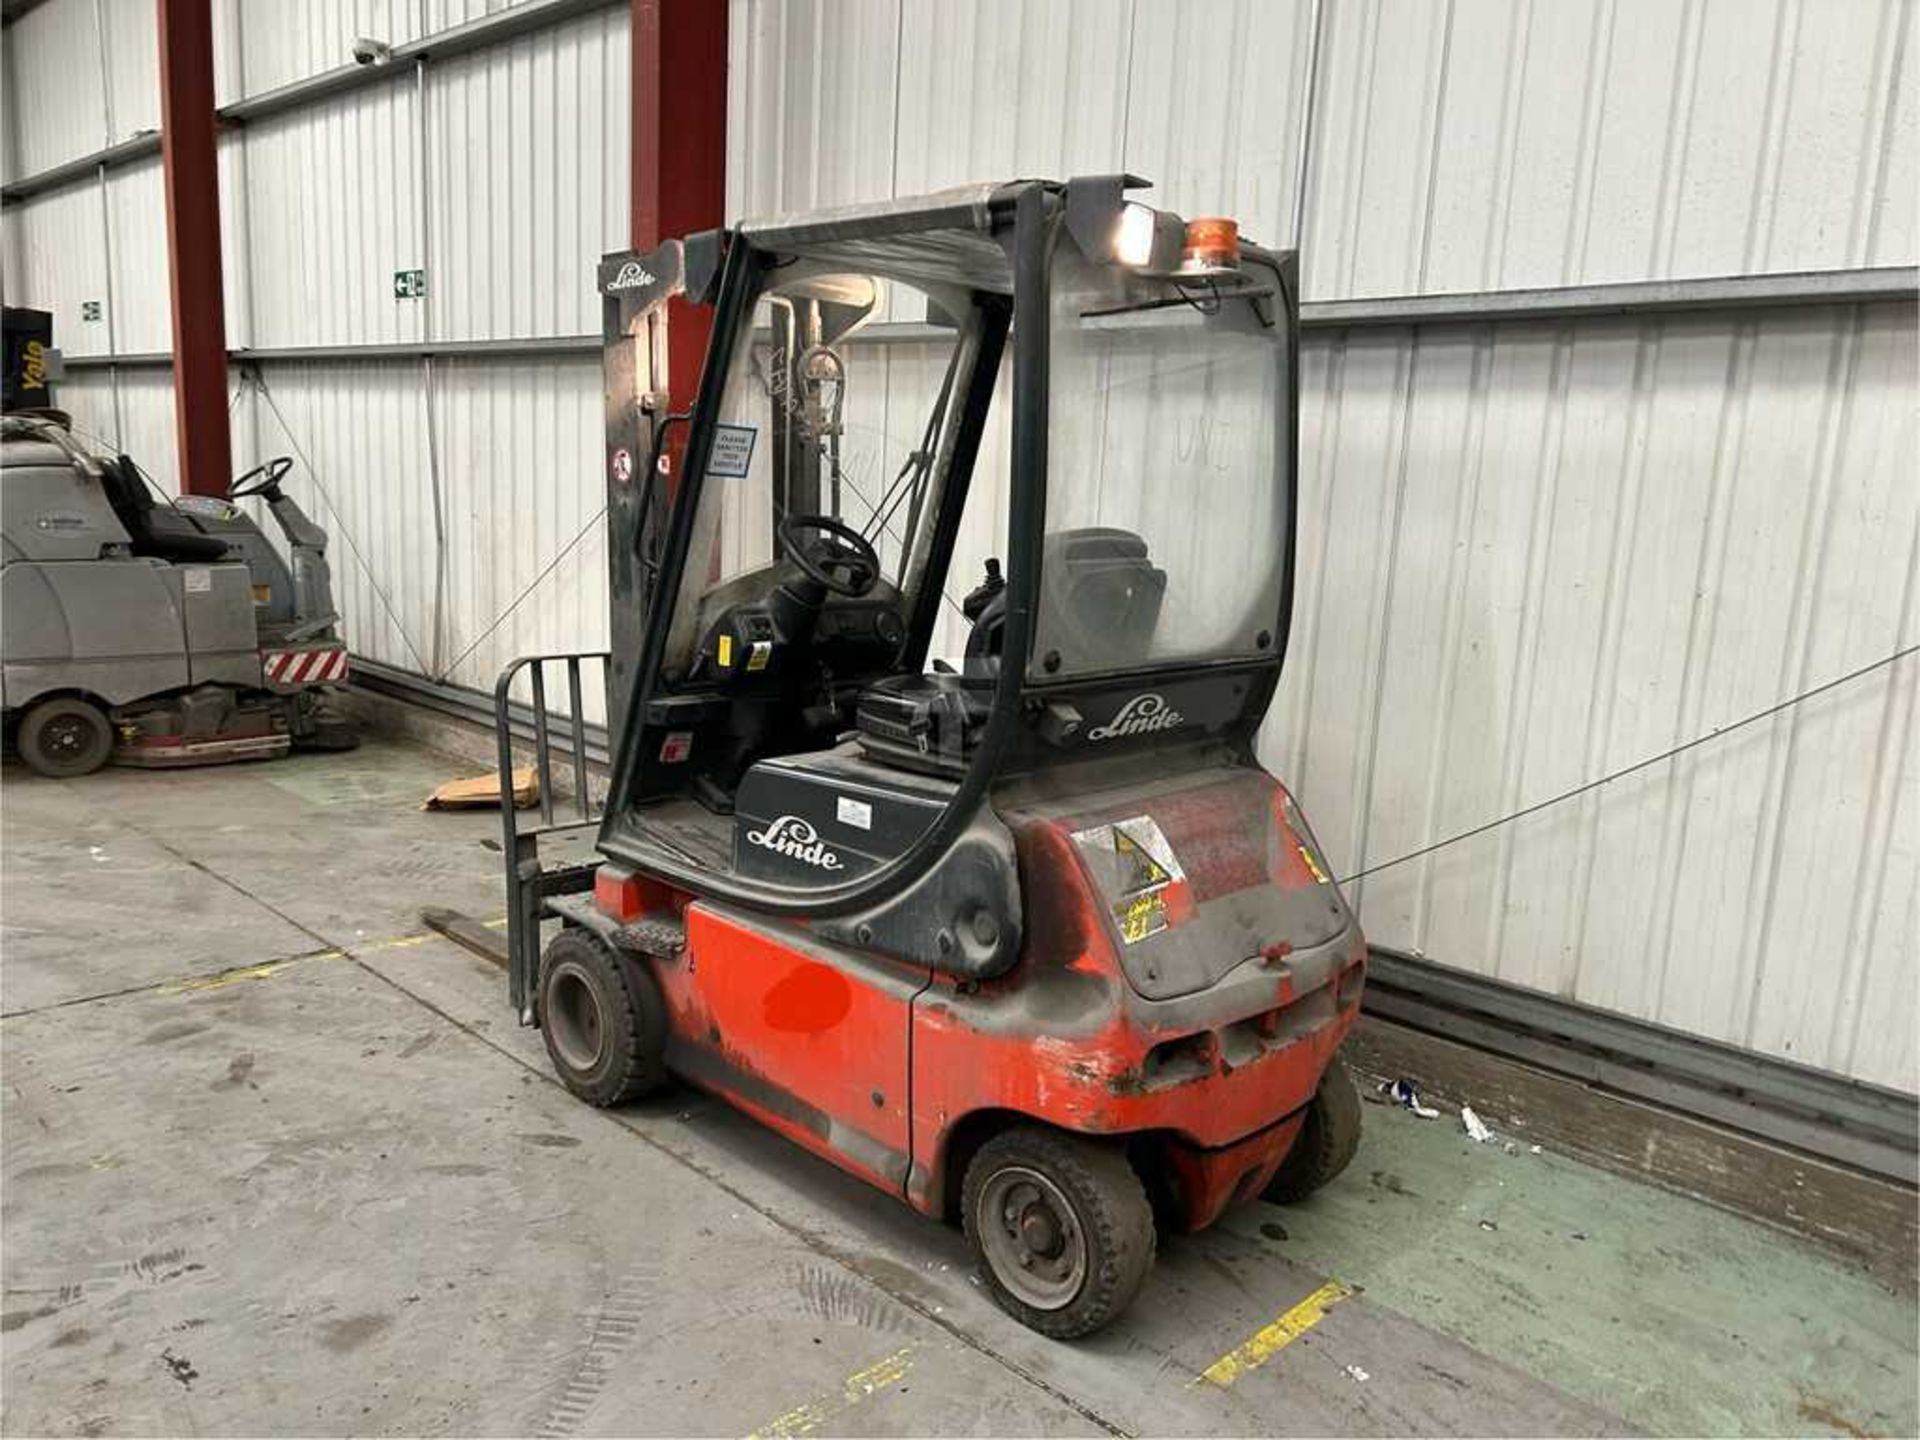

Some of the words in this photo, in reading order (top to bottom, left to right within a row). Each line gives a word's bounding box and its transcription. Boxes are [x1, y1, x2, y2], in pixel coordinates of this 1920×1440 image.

[607, 262, 655, 290] Linde
[1088, 693, 1182, 740] Linde
[747, 815, 844, 870] Linde
